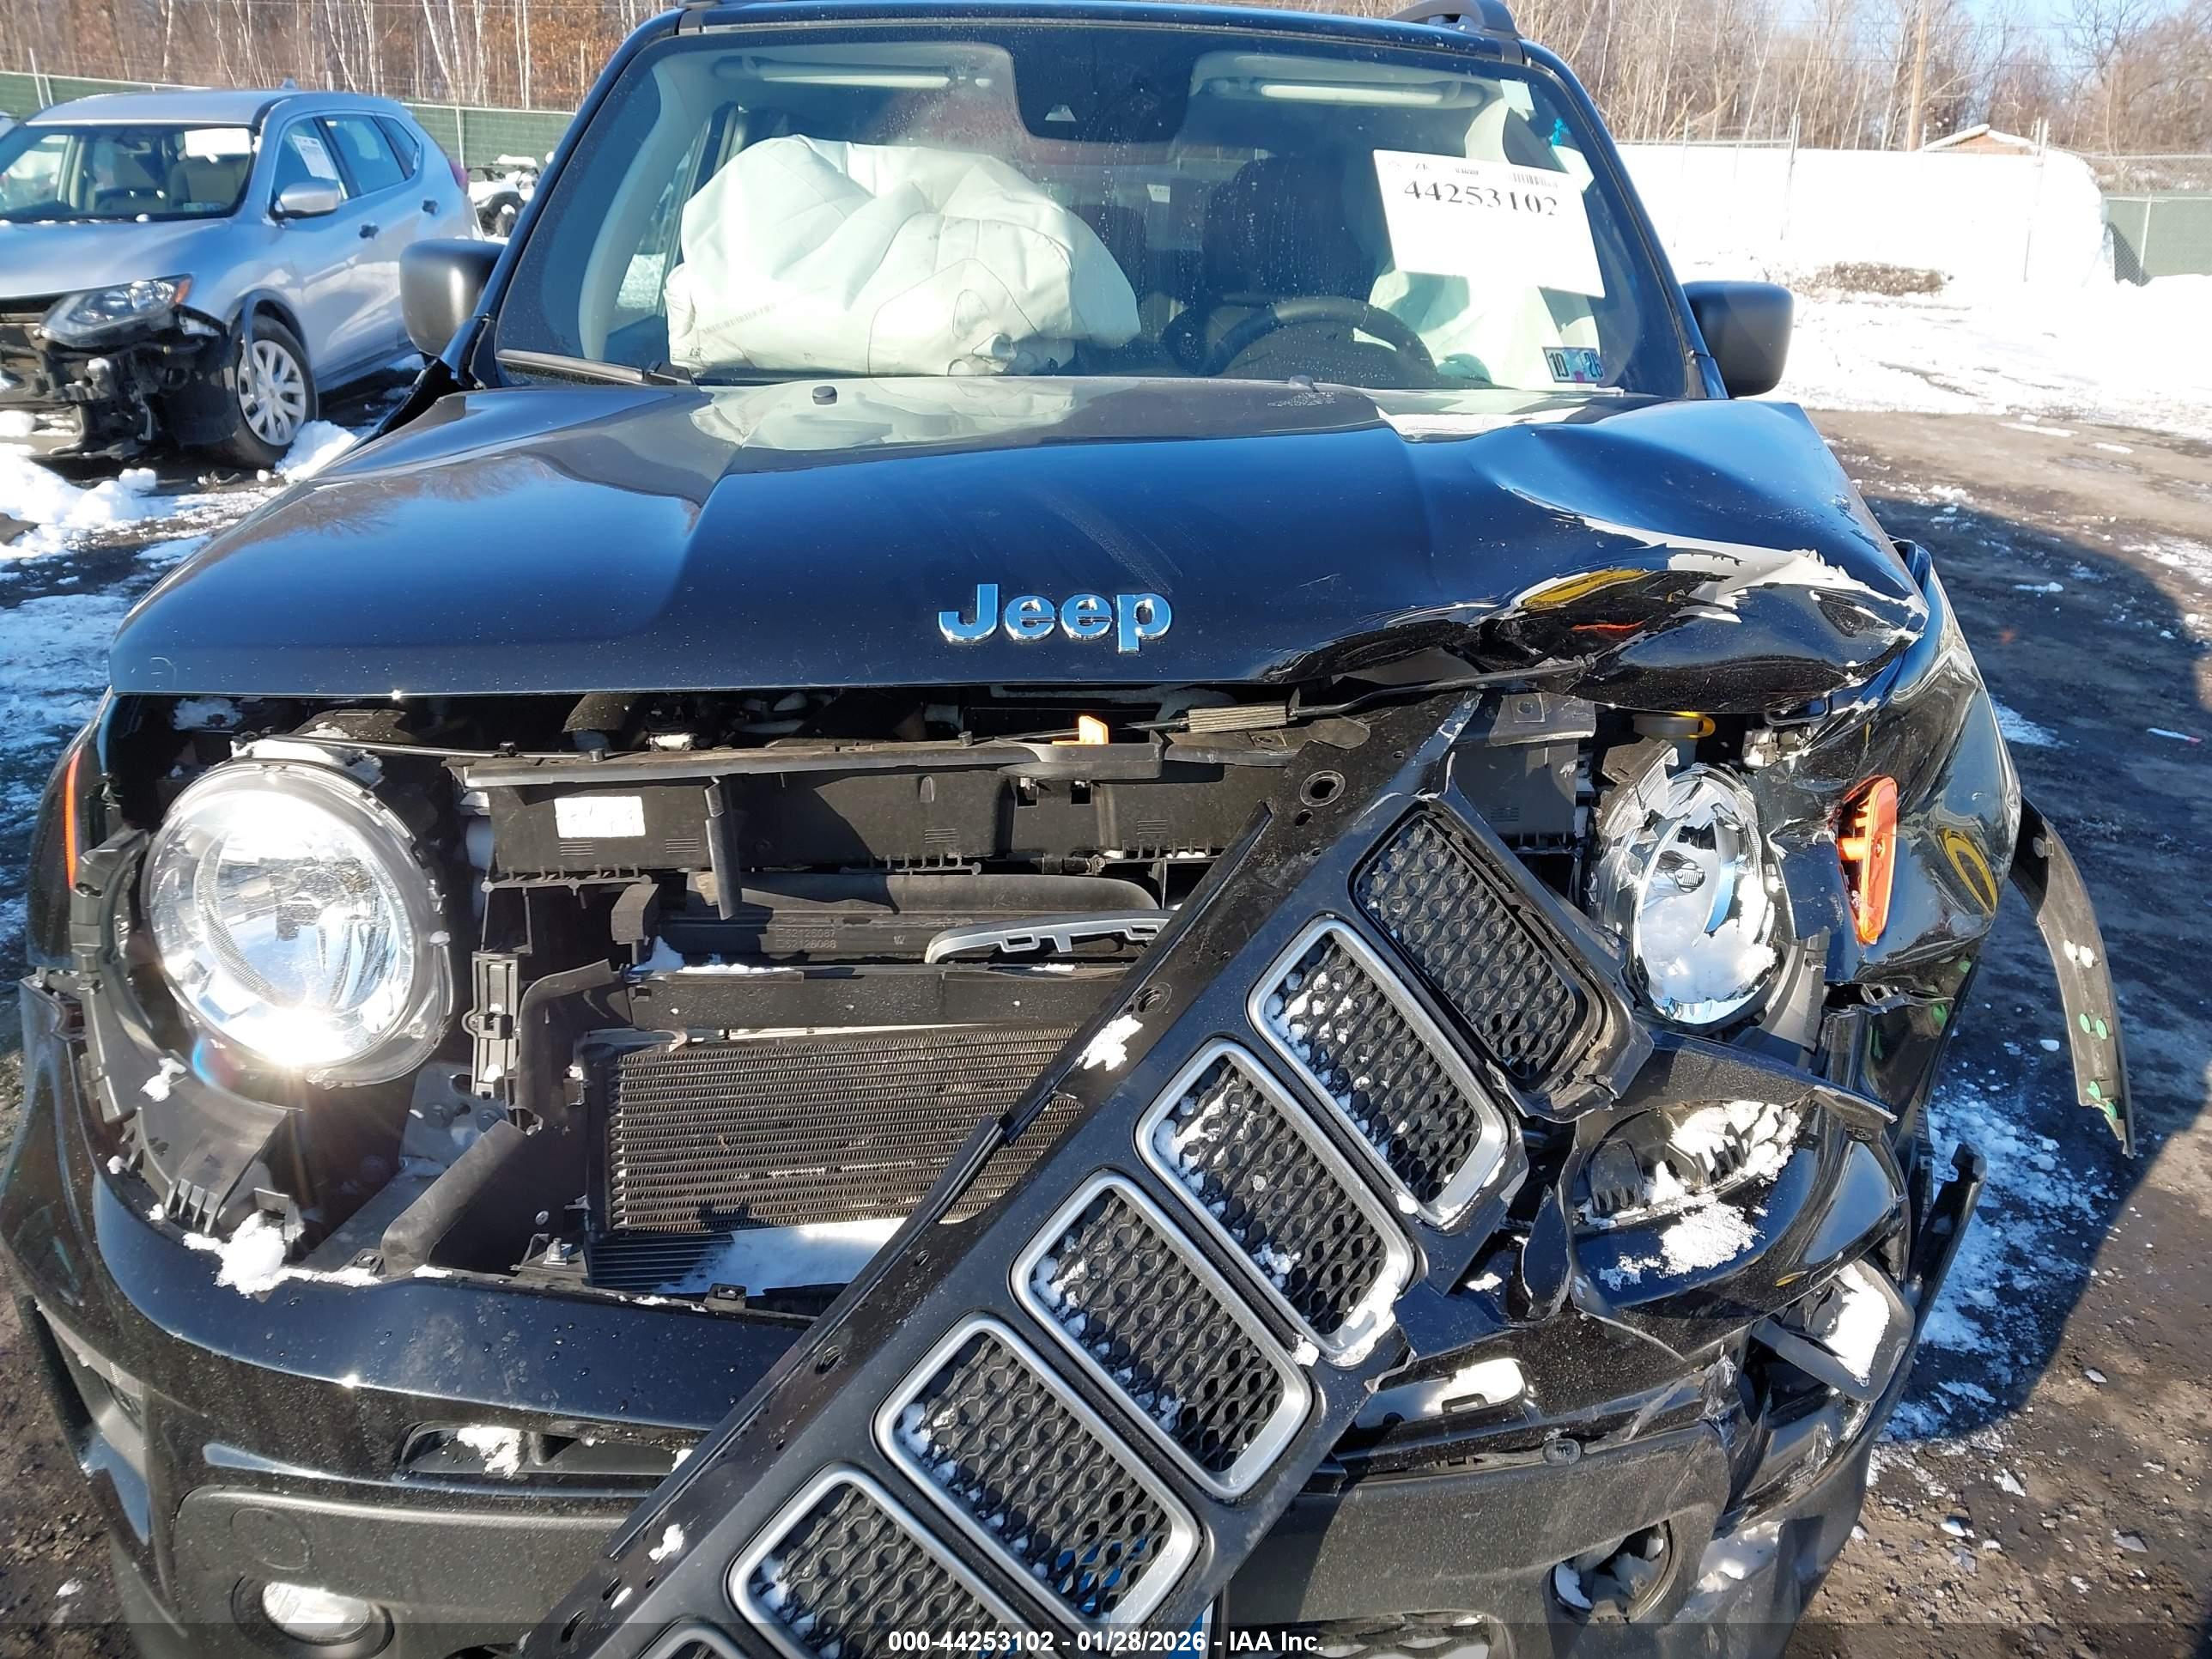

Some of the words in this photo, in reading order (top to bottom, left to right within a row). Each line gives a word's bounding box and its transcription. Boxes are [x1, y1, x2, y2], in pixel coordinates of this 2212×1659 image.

[1404, 180, 1558, 216] 44253102
[1549, 353, 1569, 377] 10
[1584, 352, 1604, 377] 26
[938, 583, 1172, 653] Jeep
